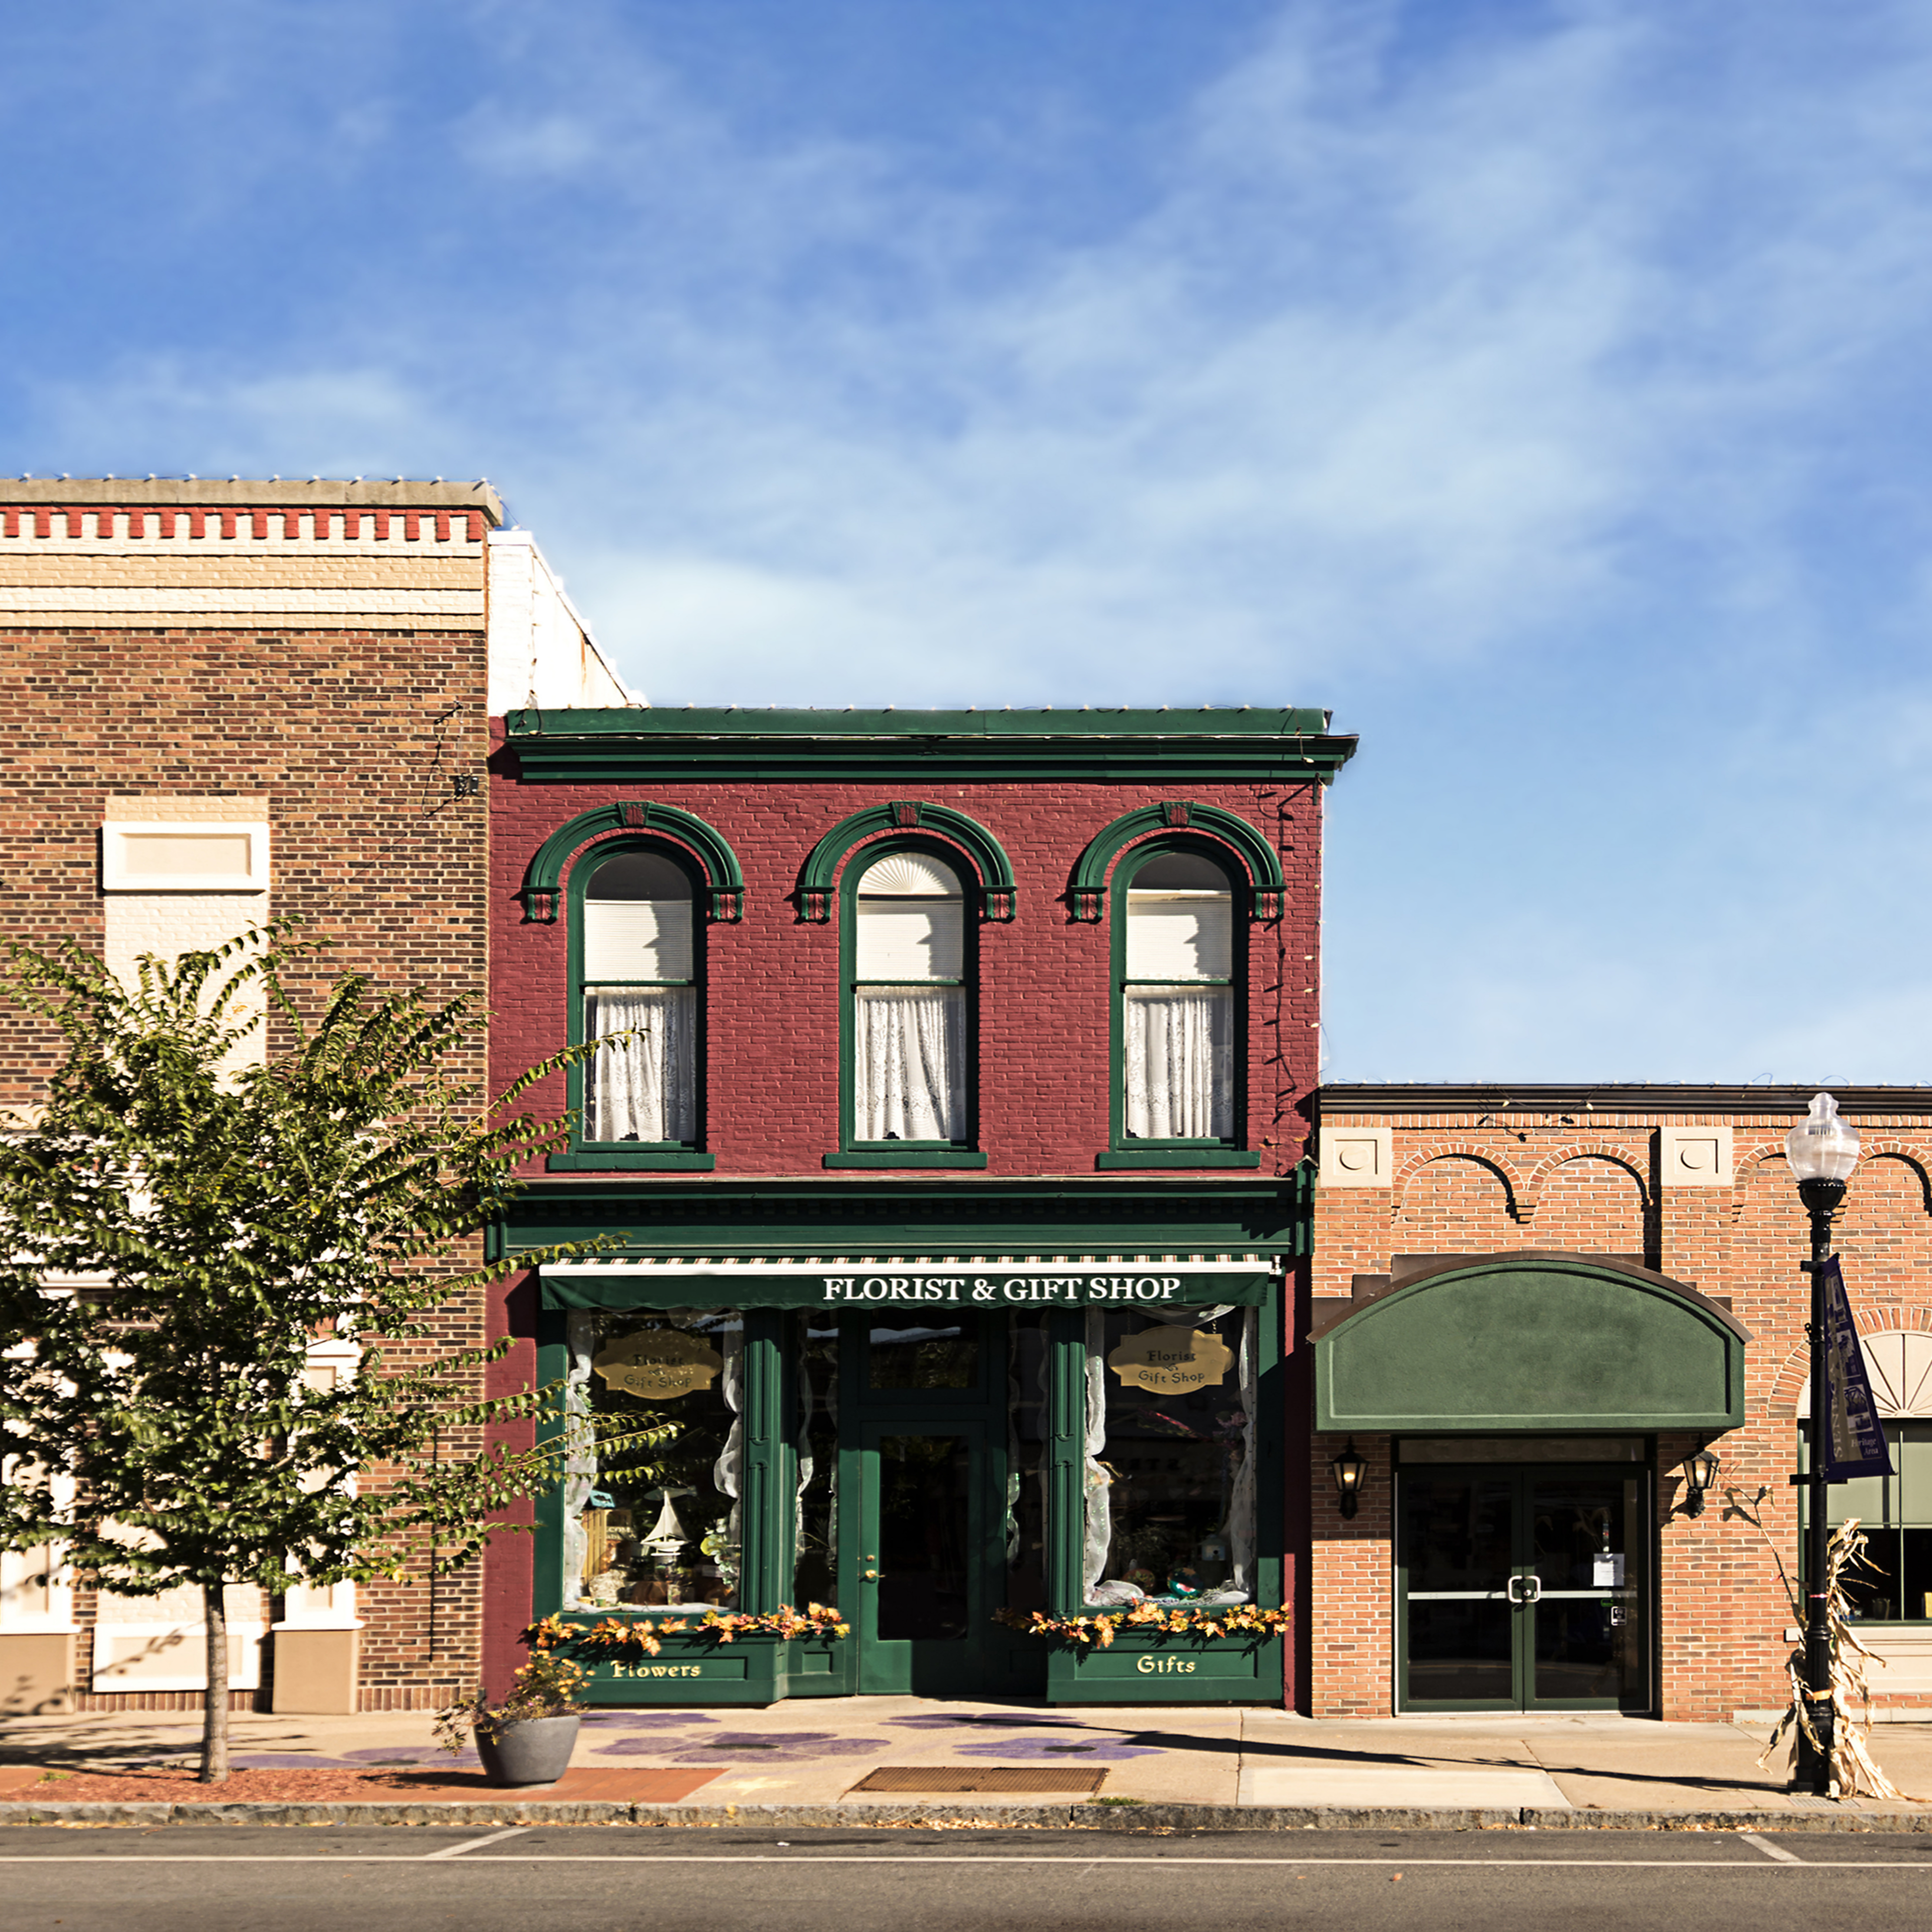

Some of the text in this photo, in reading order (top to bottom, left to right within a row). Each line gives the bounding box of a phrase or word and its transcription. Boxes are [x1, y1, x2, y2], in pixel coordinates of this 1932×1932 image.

[823, 1278, 1180, 1300] FLORIST & GIFT SHOP
[633, 1354, 683, 1365] Florist
[1147, 1350, 1197, 1361] Florist
[624, 1375, 692, 1389] Gift Shop
[1138, 1370, 1204, 1384] Gift Shop
[610, 1660, 701, 1678] Flowers
[1137, 1655, 1195, 1673] Gifts
